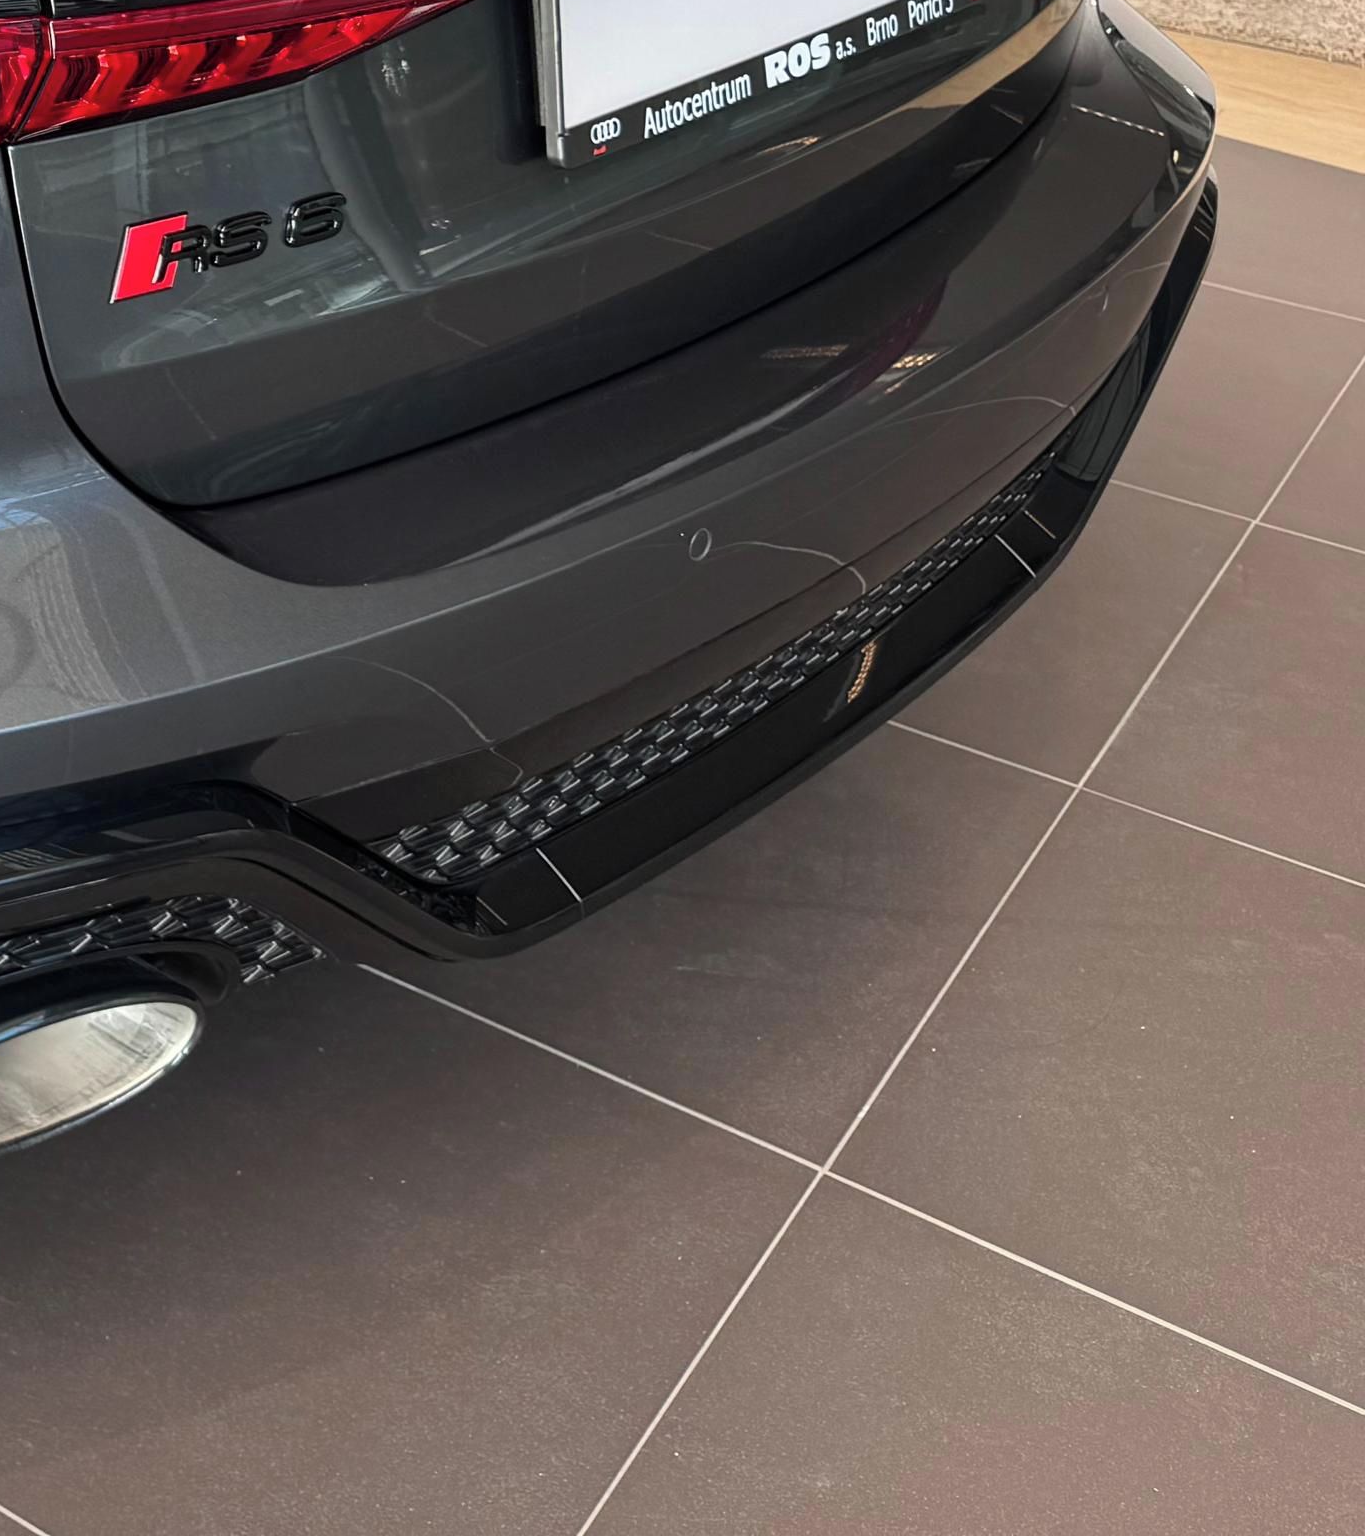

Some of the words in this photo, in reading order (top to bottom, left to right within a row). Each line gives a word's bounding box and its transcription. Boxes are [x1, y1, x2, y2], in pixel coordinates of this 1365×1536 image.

[644, 73, 752, 139] Autocentrum
[764, 32, 832, 88] ROS
[835, 36, 857, 60] a.s.
[866, 14, 899, 47] Brno
[151, 210, 273, 284] RS
[283, 191, 347, 248] 6
